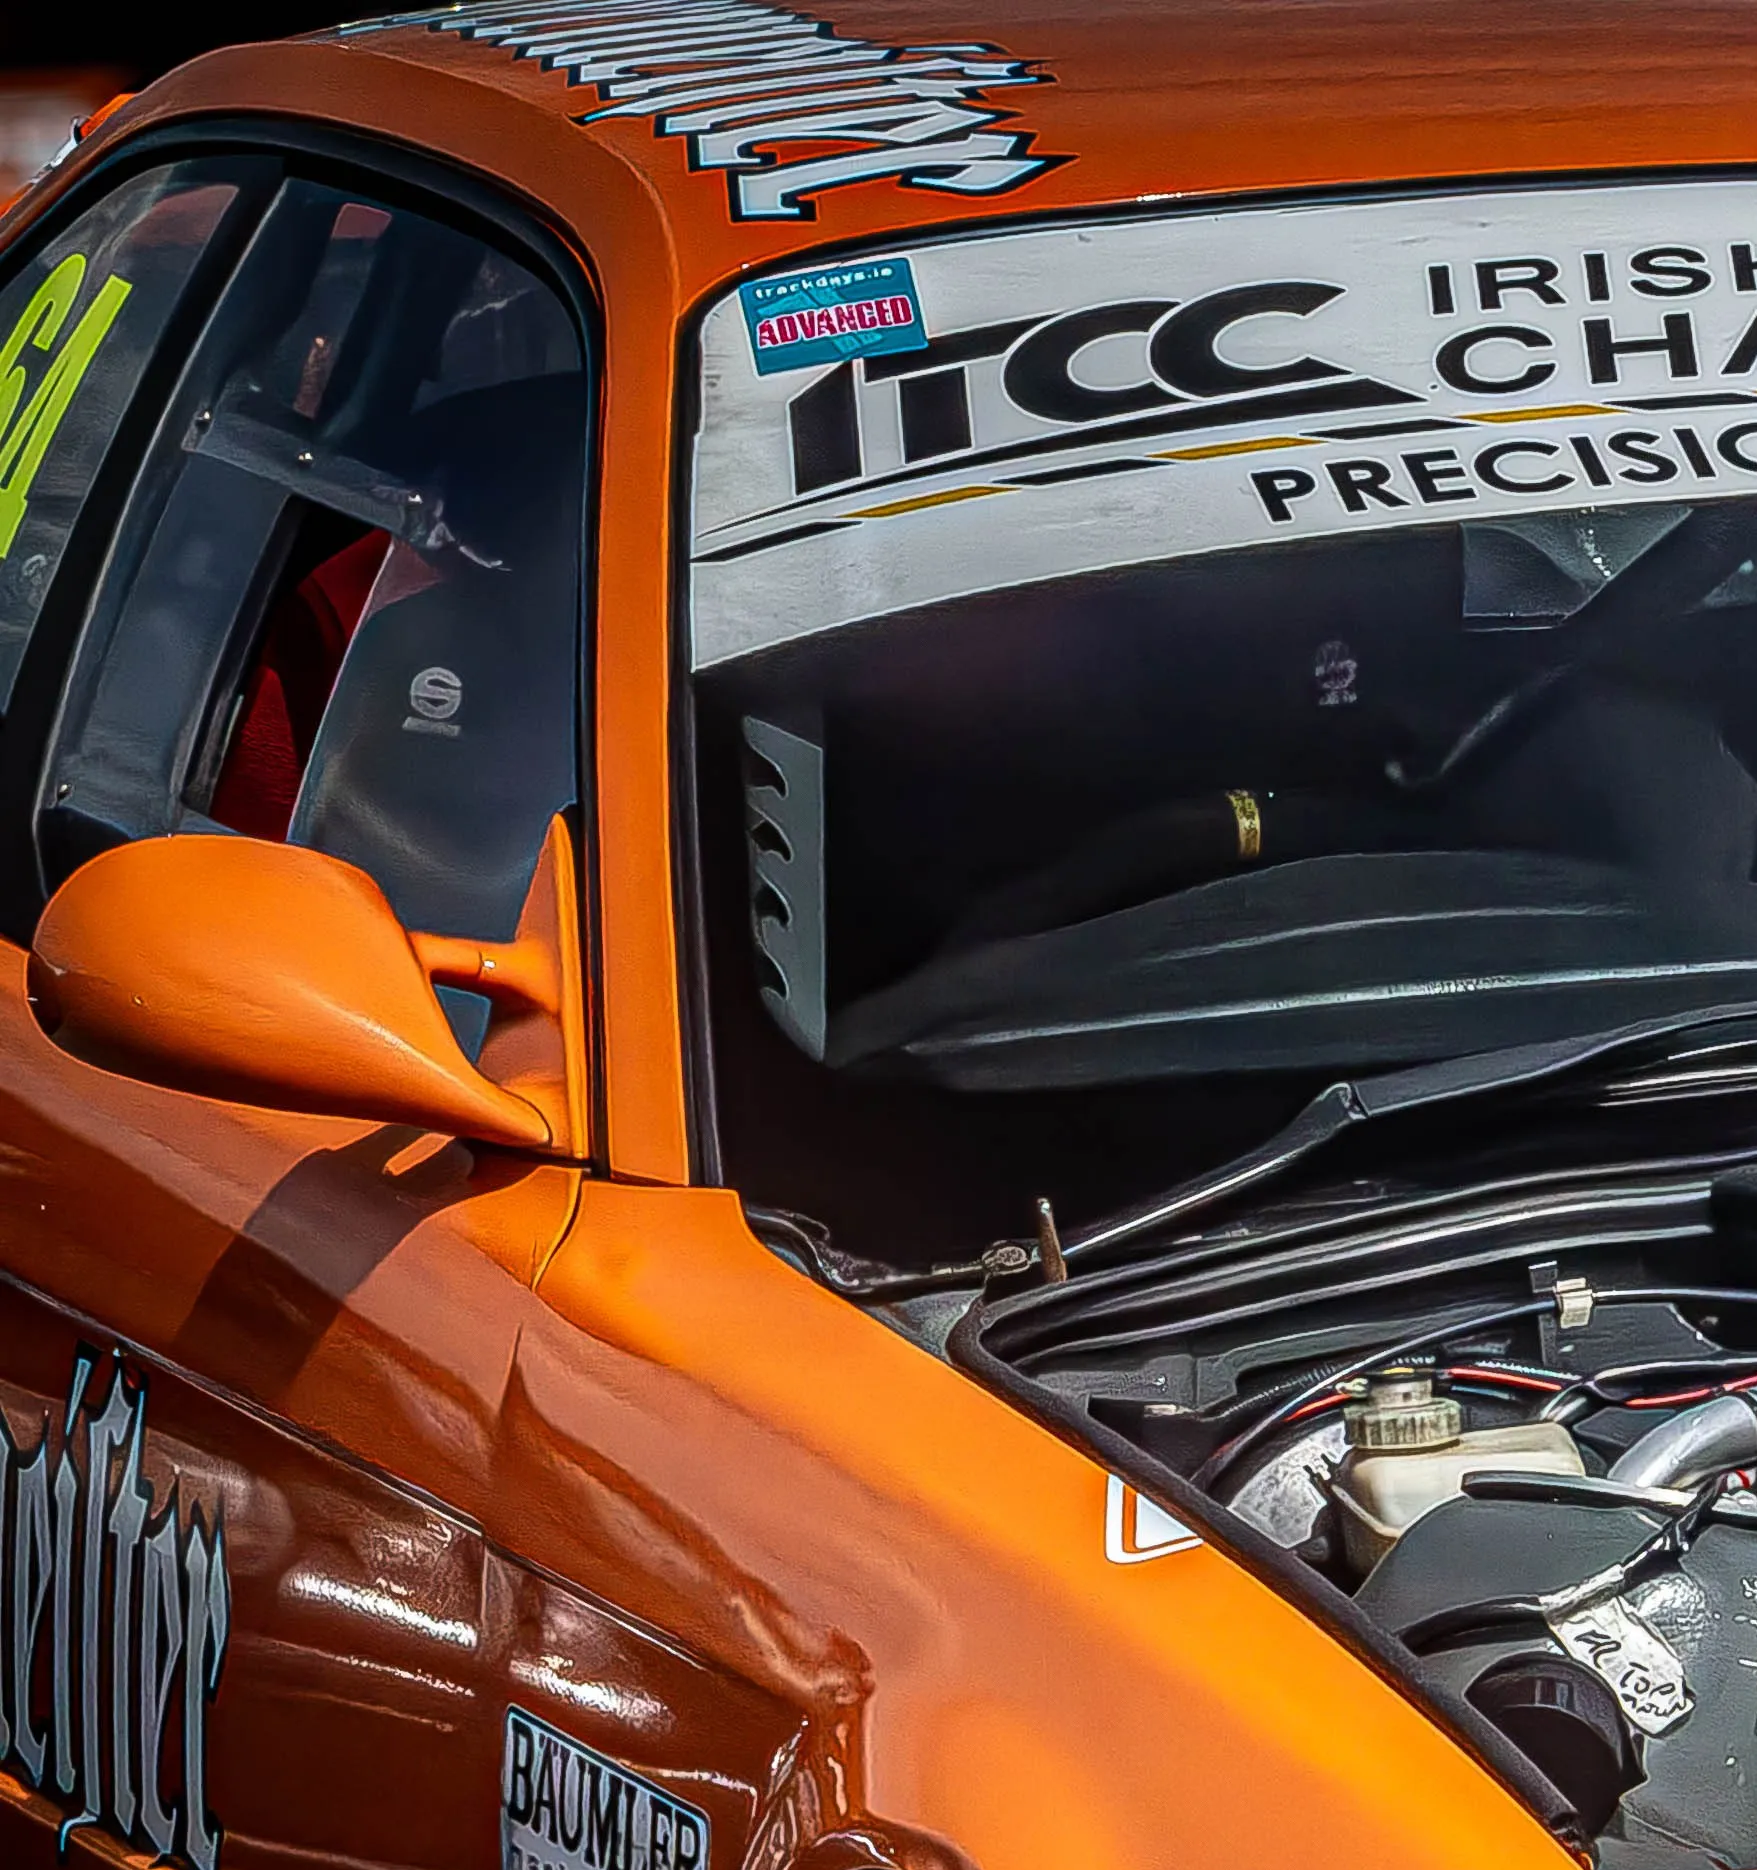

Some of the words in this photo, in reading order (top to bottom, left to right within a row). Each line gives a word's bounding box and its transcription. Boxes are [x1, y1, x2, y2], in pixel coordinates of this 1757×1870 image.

[755, 266, 893, 299] trackdays.ie
[757, 295, 914, 349] ADVANCED
[788, 280, 1352, 499] ITCC
